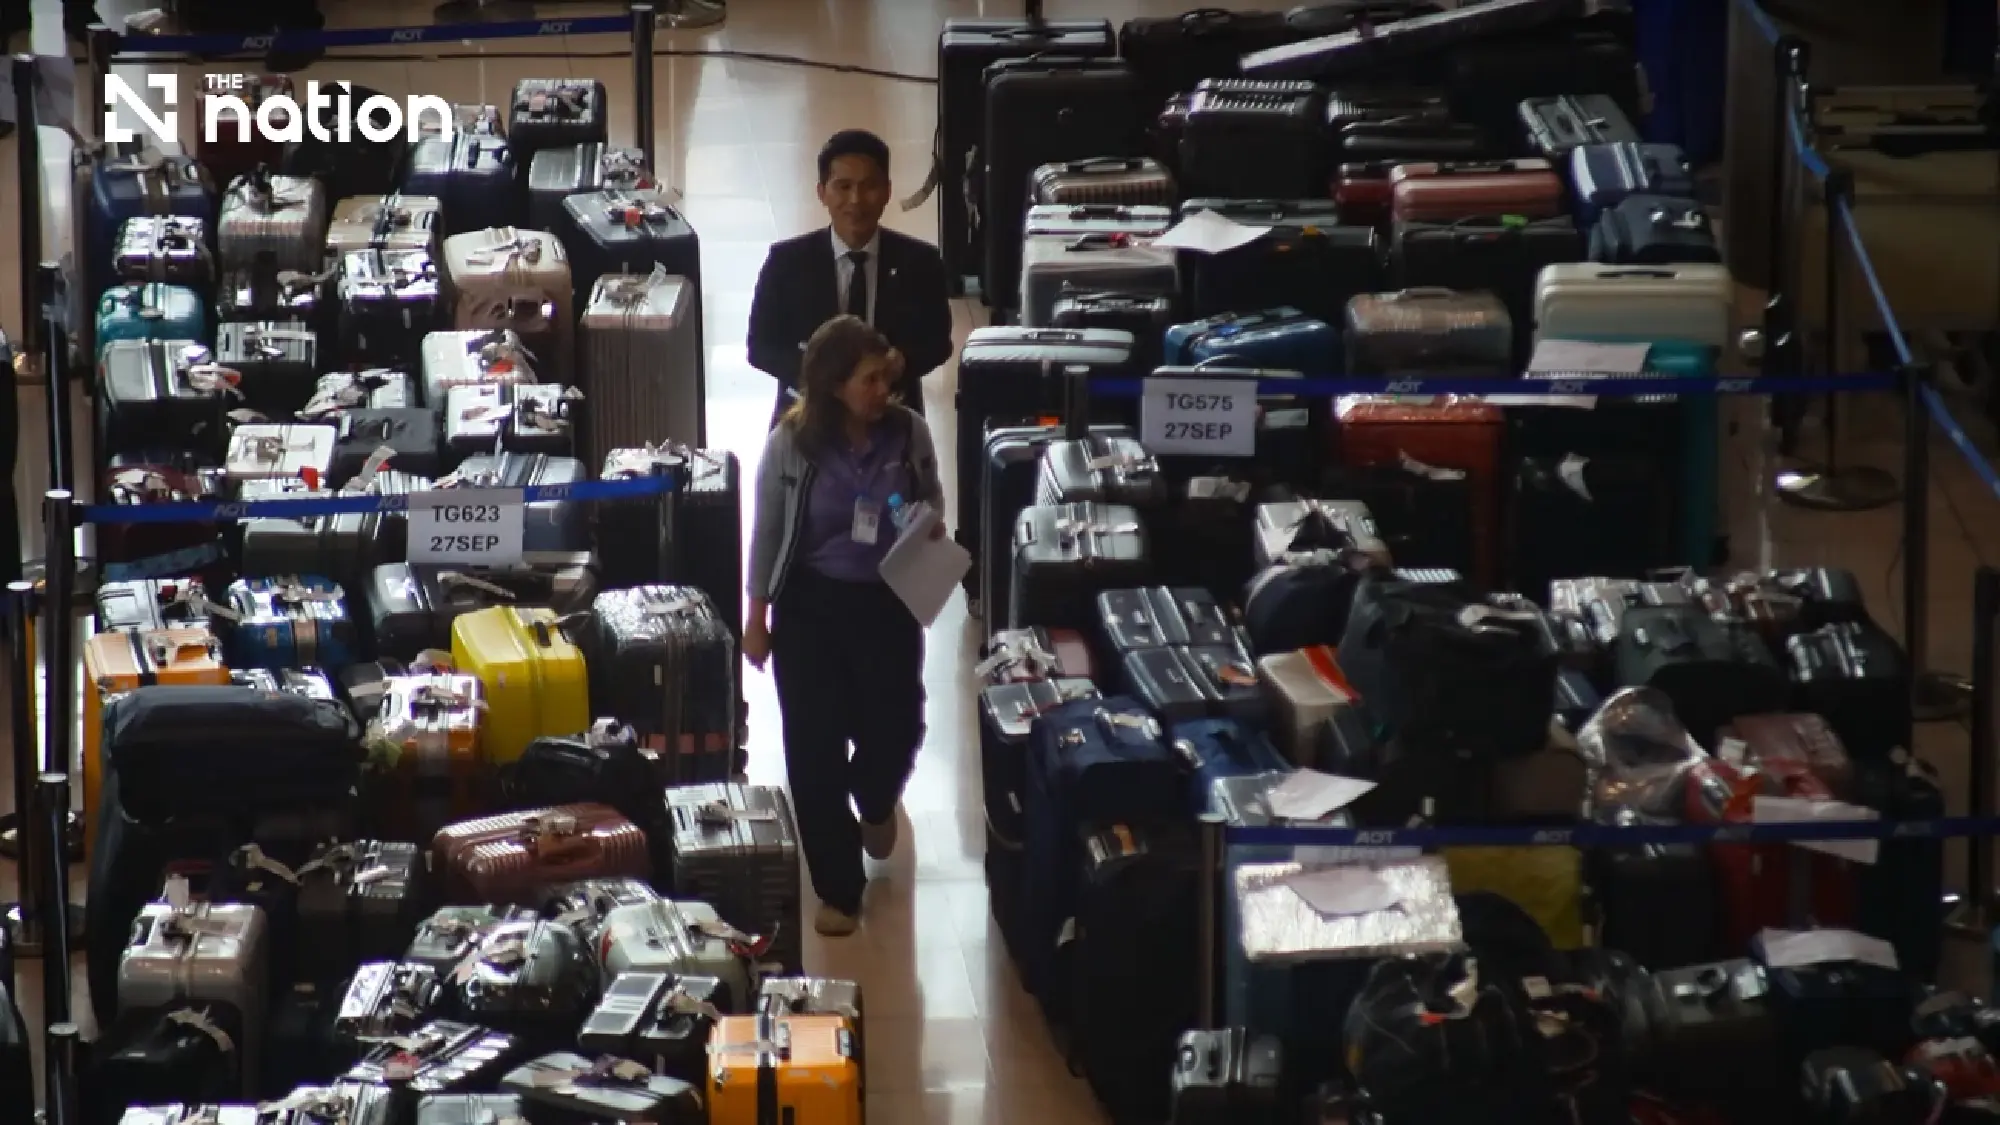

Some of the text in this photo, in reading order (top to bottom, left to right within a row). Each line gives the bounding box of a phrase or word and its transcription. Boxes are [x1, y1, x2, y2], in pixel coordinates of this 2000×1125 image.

[391, 28, 425, 42] AOT
[539, 22, 573, 34] AOT
[242, 35, 274, 49] AOT
[1385, 379, 1423, 393] AOT
[1550, 380, 1587, 392] AOT
[1715, 379, 1753, 392] AOT
[1166, 393, 1233, 411] TG575
[1165, 422, 1232, 440] 27SEP
[538, 485, 571, 498] AOT
[213, 502, 249, 518] AOT
[431, 504, 500, 522] TG623
[430, 535, 500, 551] 27SEP
[1355, 830, 1396, 844] AOT
[1533, 829, 1574, 843] AOT
